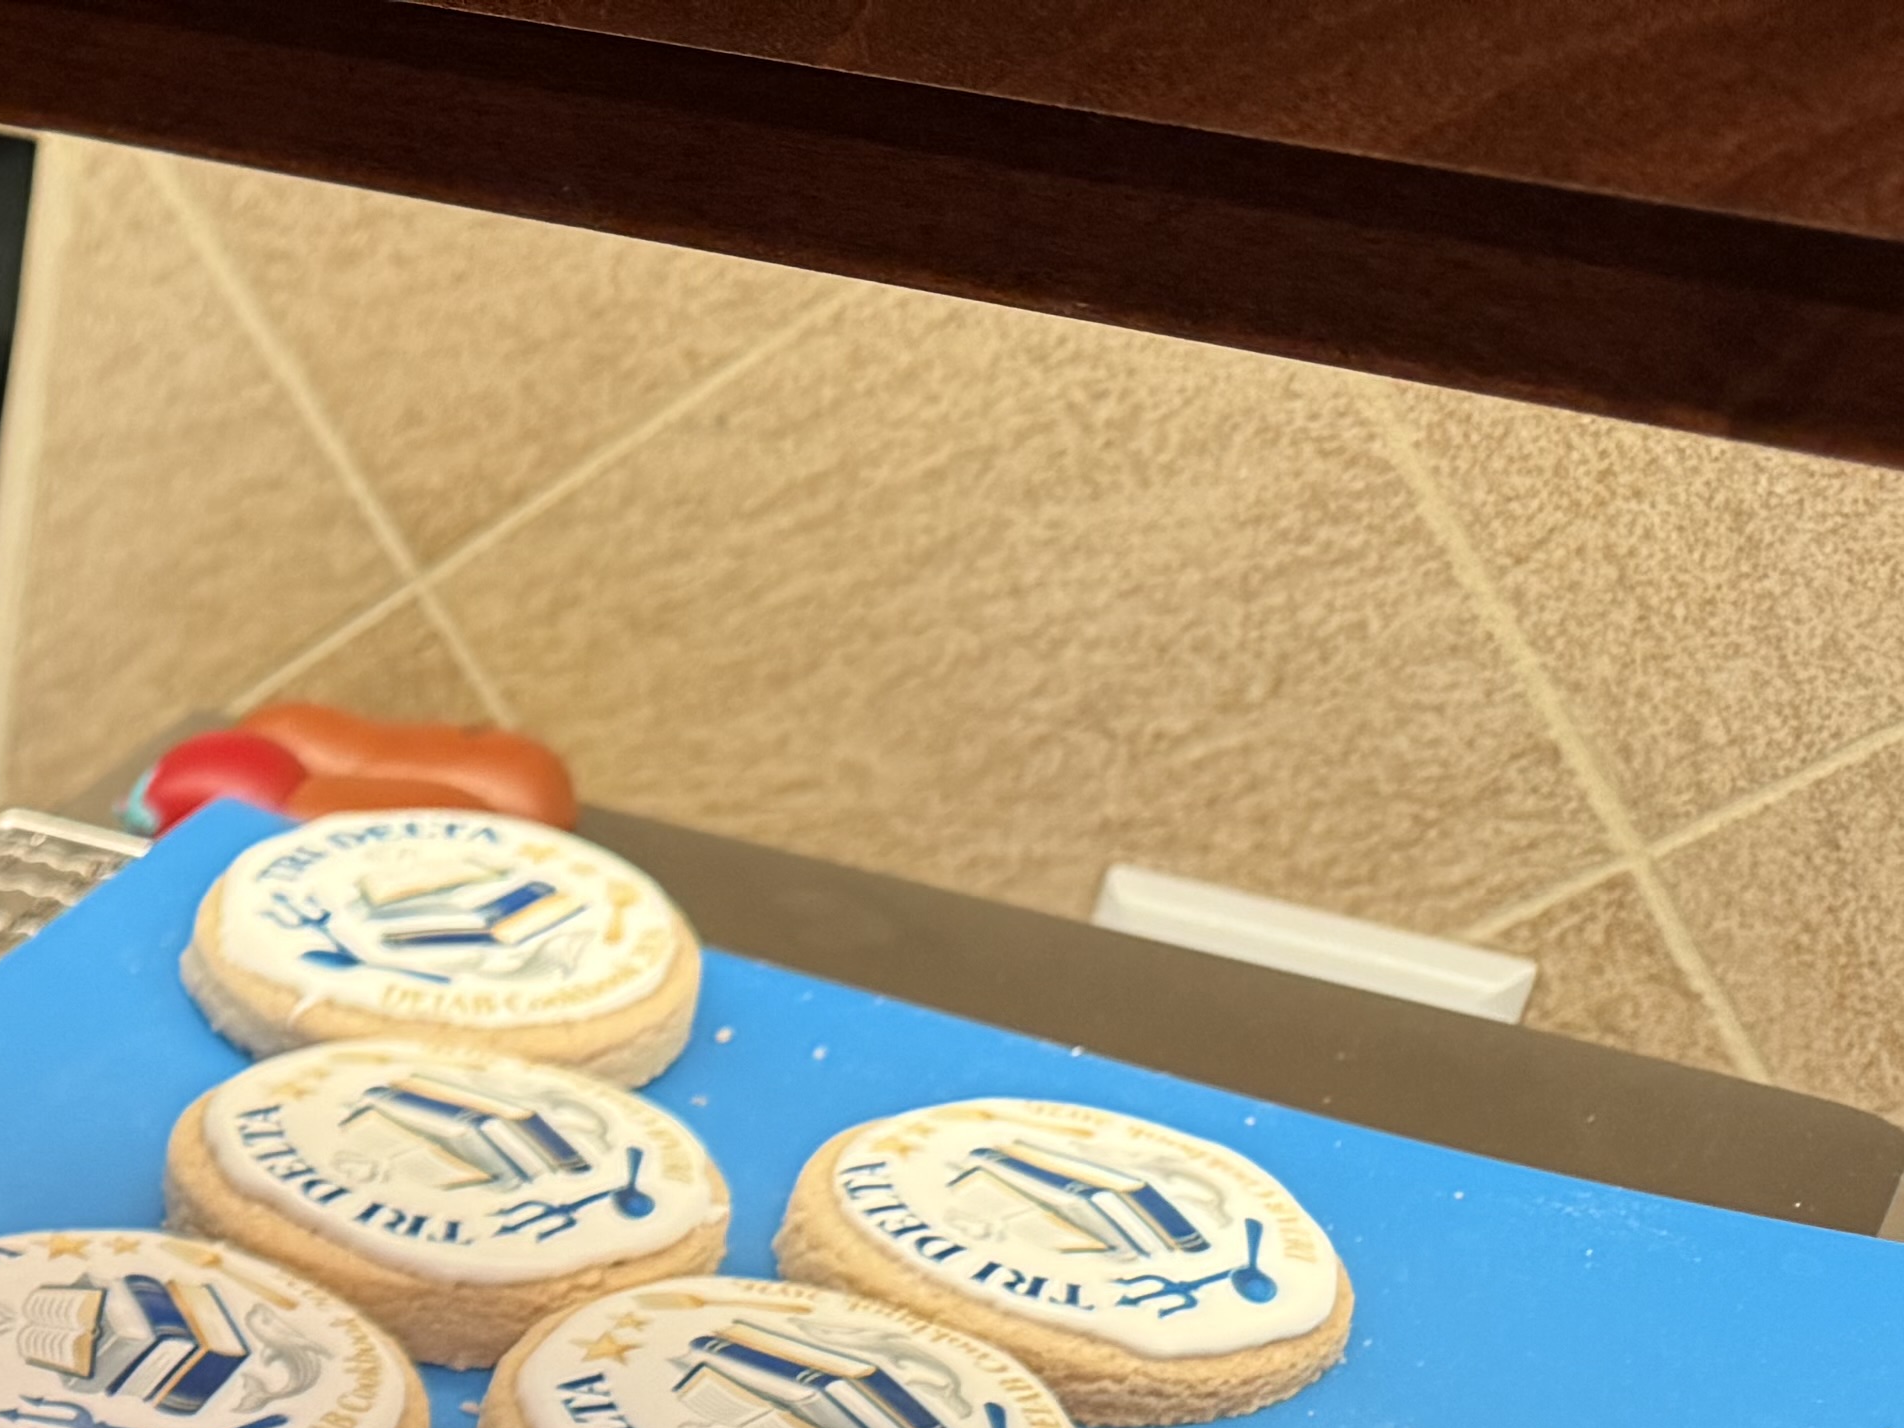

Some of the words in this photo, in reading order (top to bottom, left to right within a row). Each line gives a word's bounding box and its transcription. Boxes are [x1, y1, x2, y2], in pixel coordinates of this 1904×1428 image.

[237, 1104, 354, 1205] DELTA
[352, 1203, 475, 1246] TRI
[839, 1161, 967, 1265] DELTA
[971, 1261, 1096, 1311] TRI
